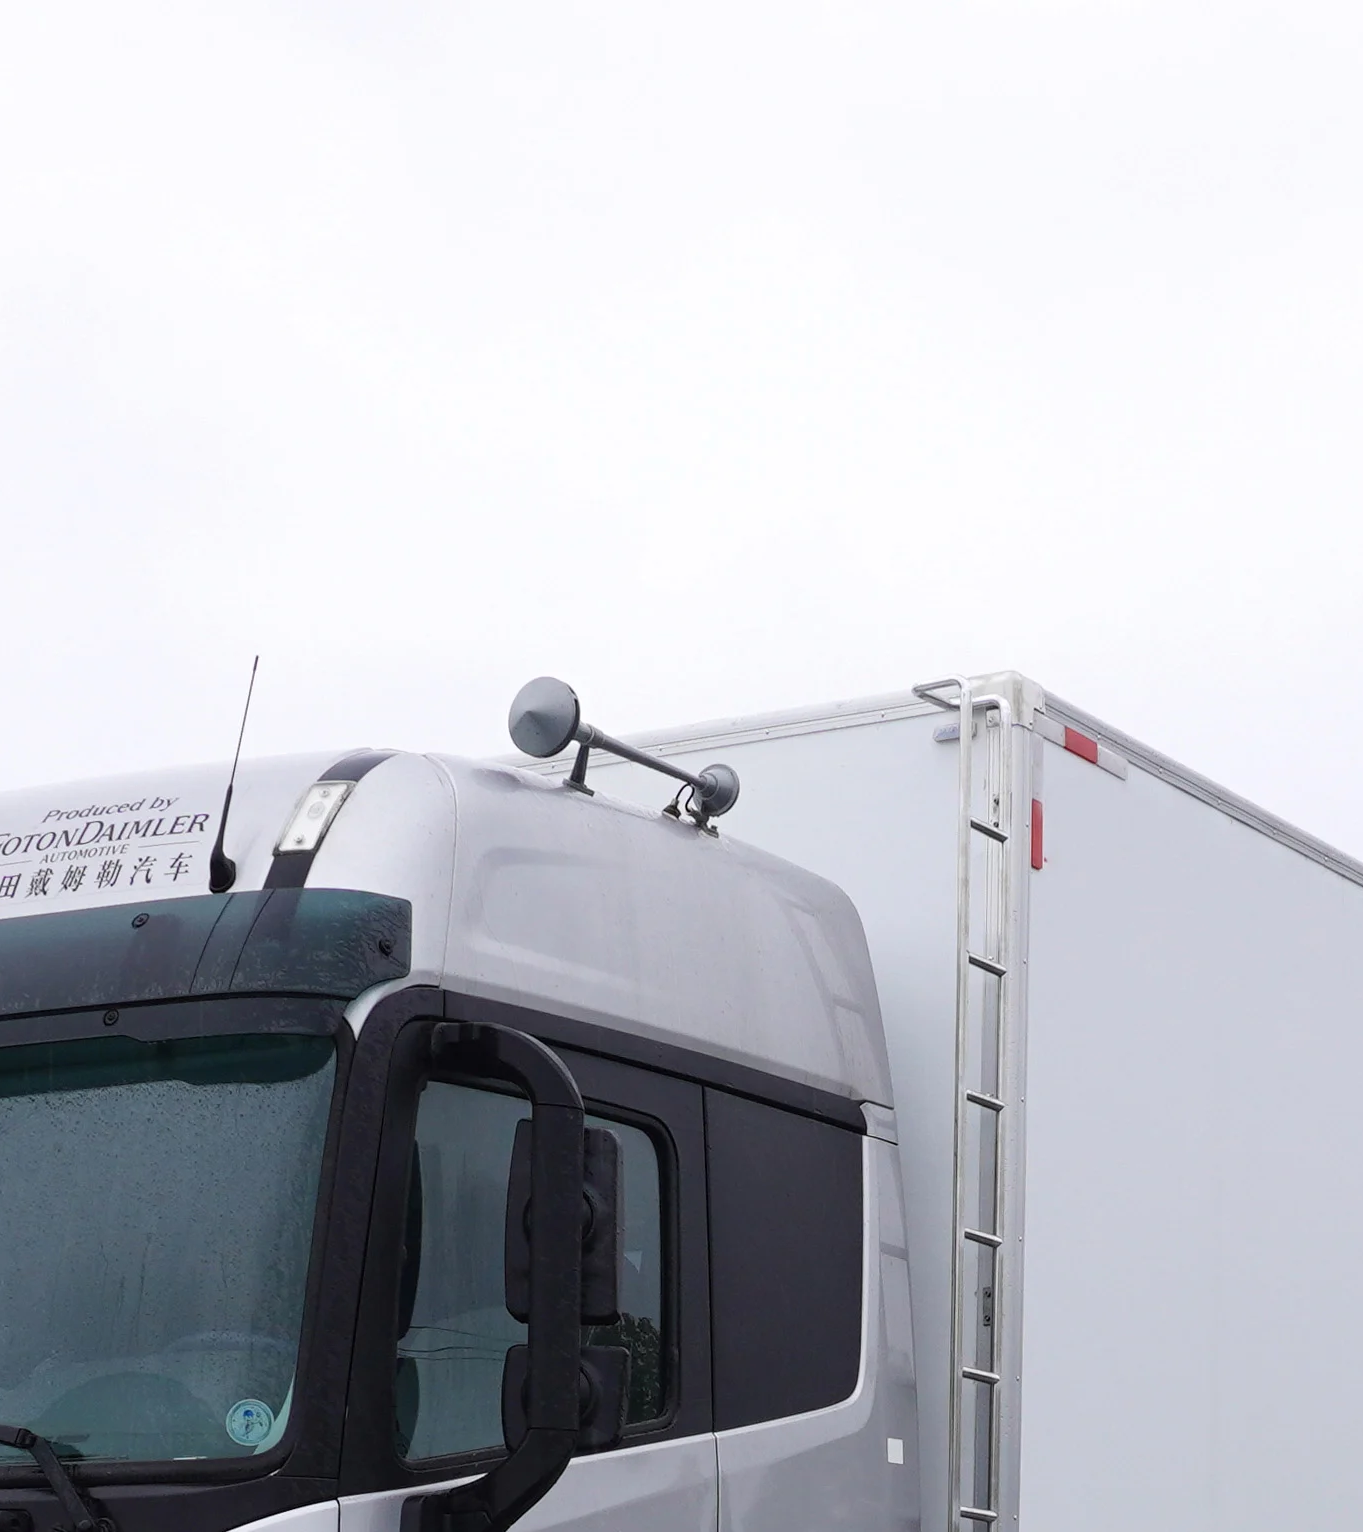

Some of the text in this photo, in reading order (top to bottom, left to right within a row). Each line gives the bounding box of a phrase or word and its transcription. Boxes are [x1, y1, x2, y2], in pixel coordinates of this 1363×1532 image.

[41, 796, 179, 823] Produced by
[39, 844, 129, 865] AUTOMOTIVE
